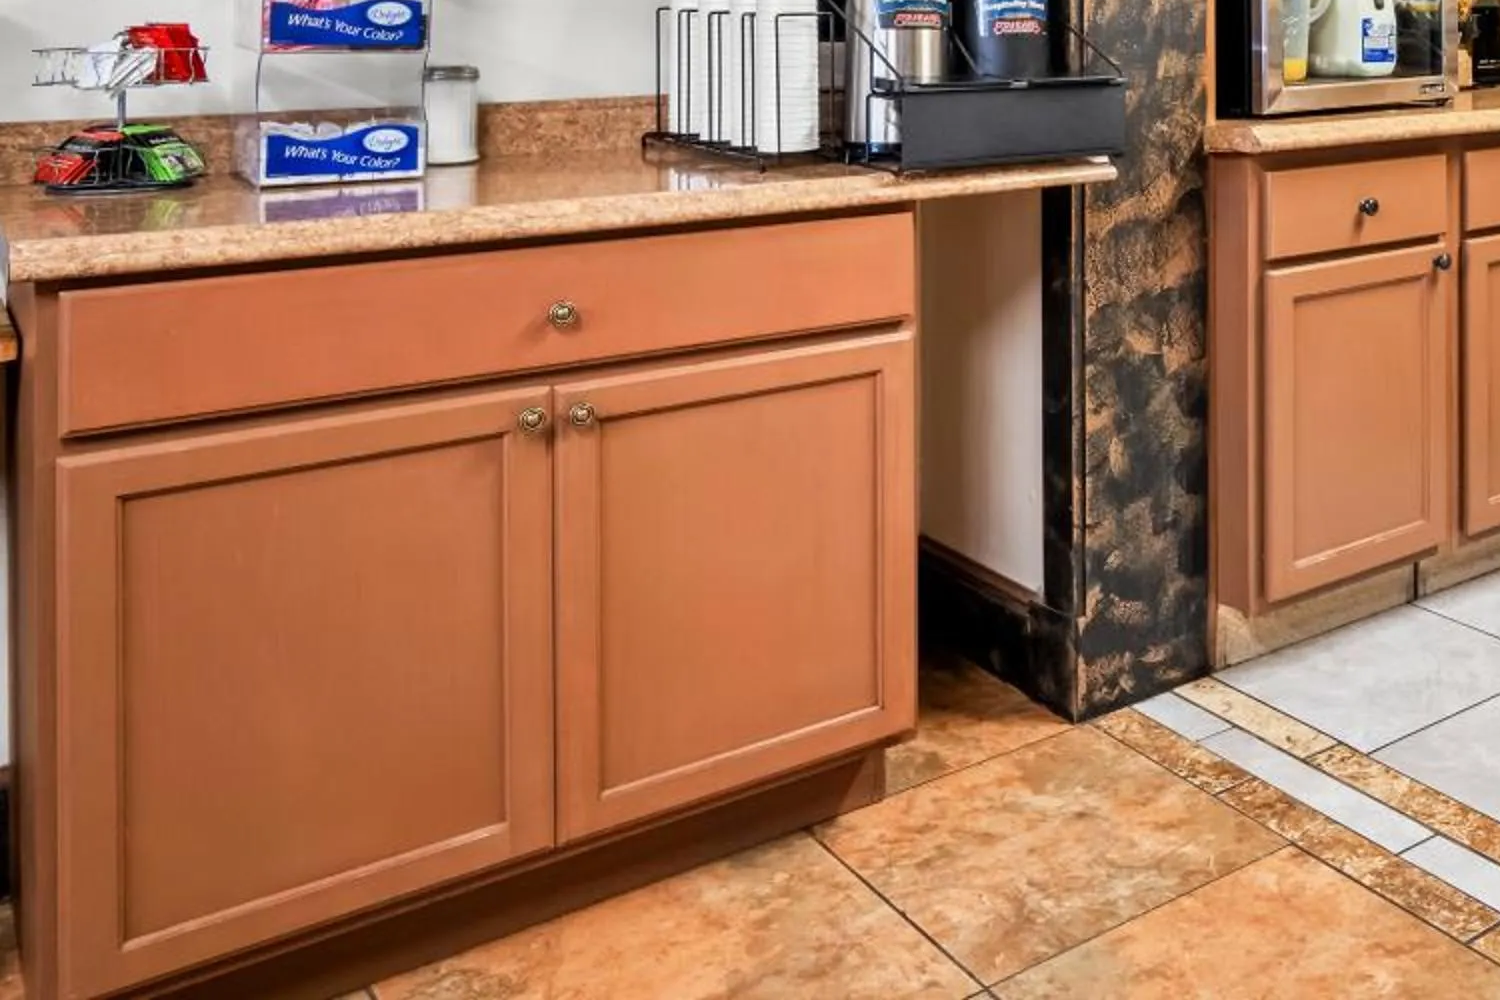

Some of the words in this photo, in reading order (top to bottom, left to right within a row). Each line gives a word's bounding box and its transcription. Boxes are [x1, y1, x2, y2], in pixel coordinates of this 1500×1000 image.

[288, 13, 333, 30] What's
[335, 21, 362, 36] Your
[363, 27, 405, 41] Color?
[284, 145, 328, 161] What's
[331, 150, 359, 165] Your
[359, 155, 401, 168] Color?
